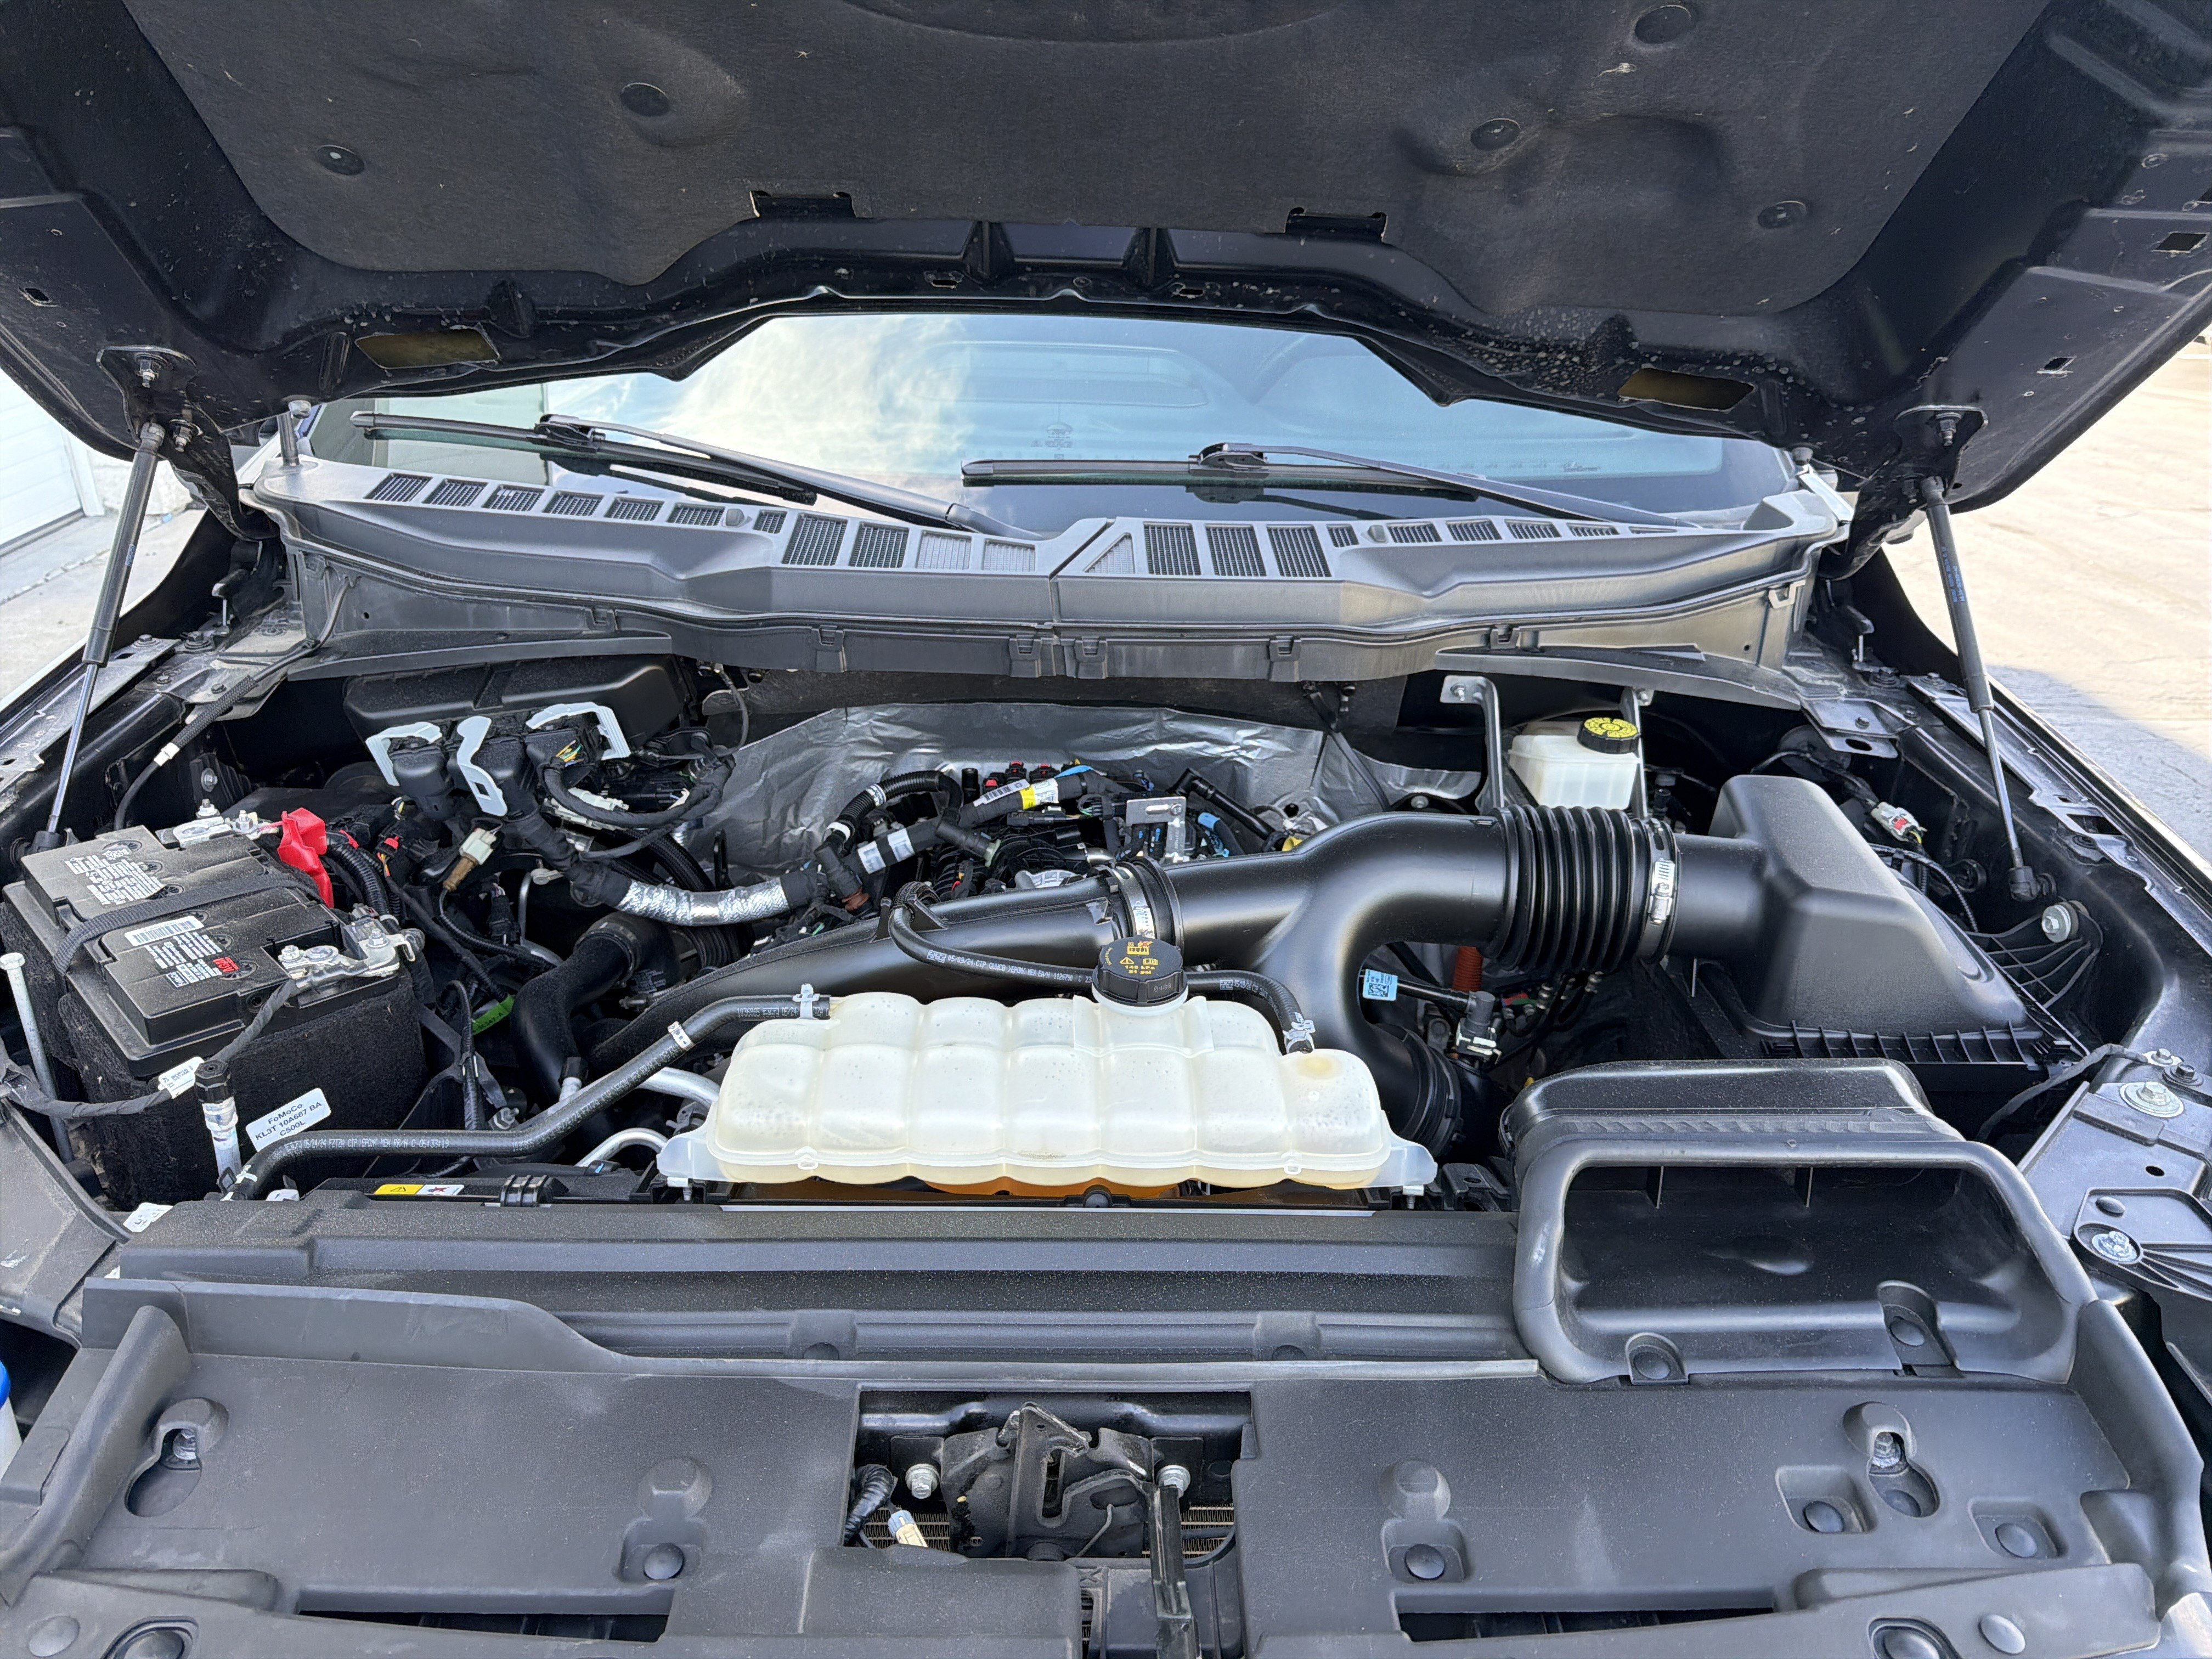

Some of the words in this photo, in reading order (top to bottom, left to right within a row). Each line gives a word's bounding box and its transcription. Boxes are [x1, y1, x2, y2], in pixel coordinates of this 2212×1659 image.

[255, 1125, 278, 1141] KL3T
[279, 1109, 308, 1127] 10A687
[309, 1102, 322, 1111] BA
[268, 1104, 303, 1124] FoMoCo
[279, 1120, 306, 1136] C500L
